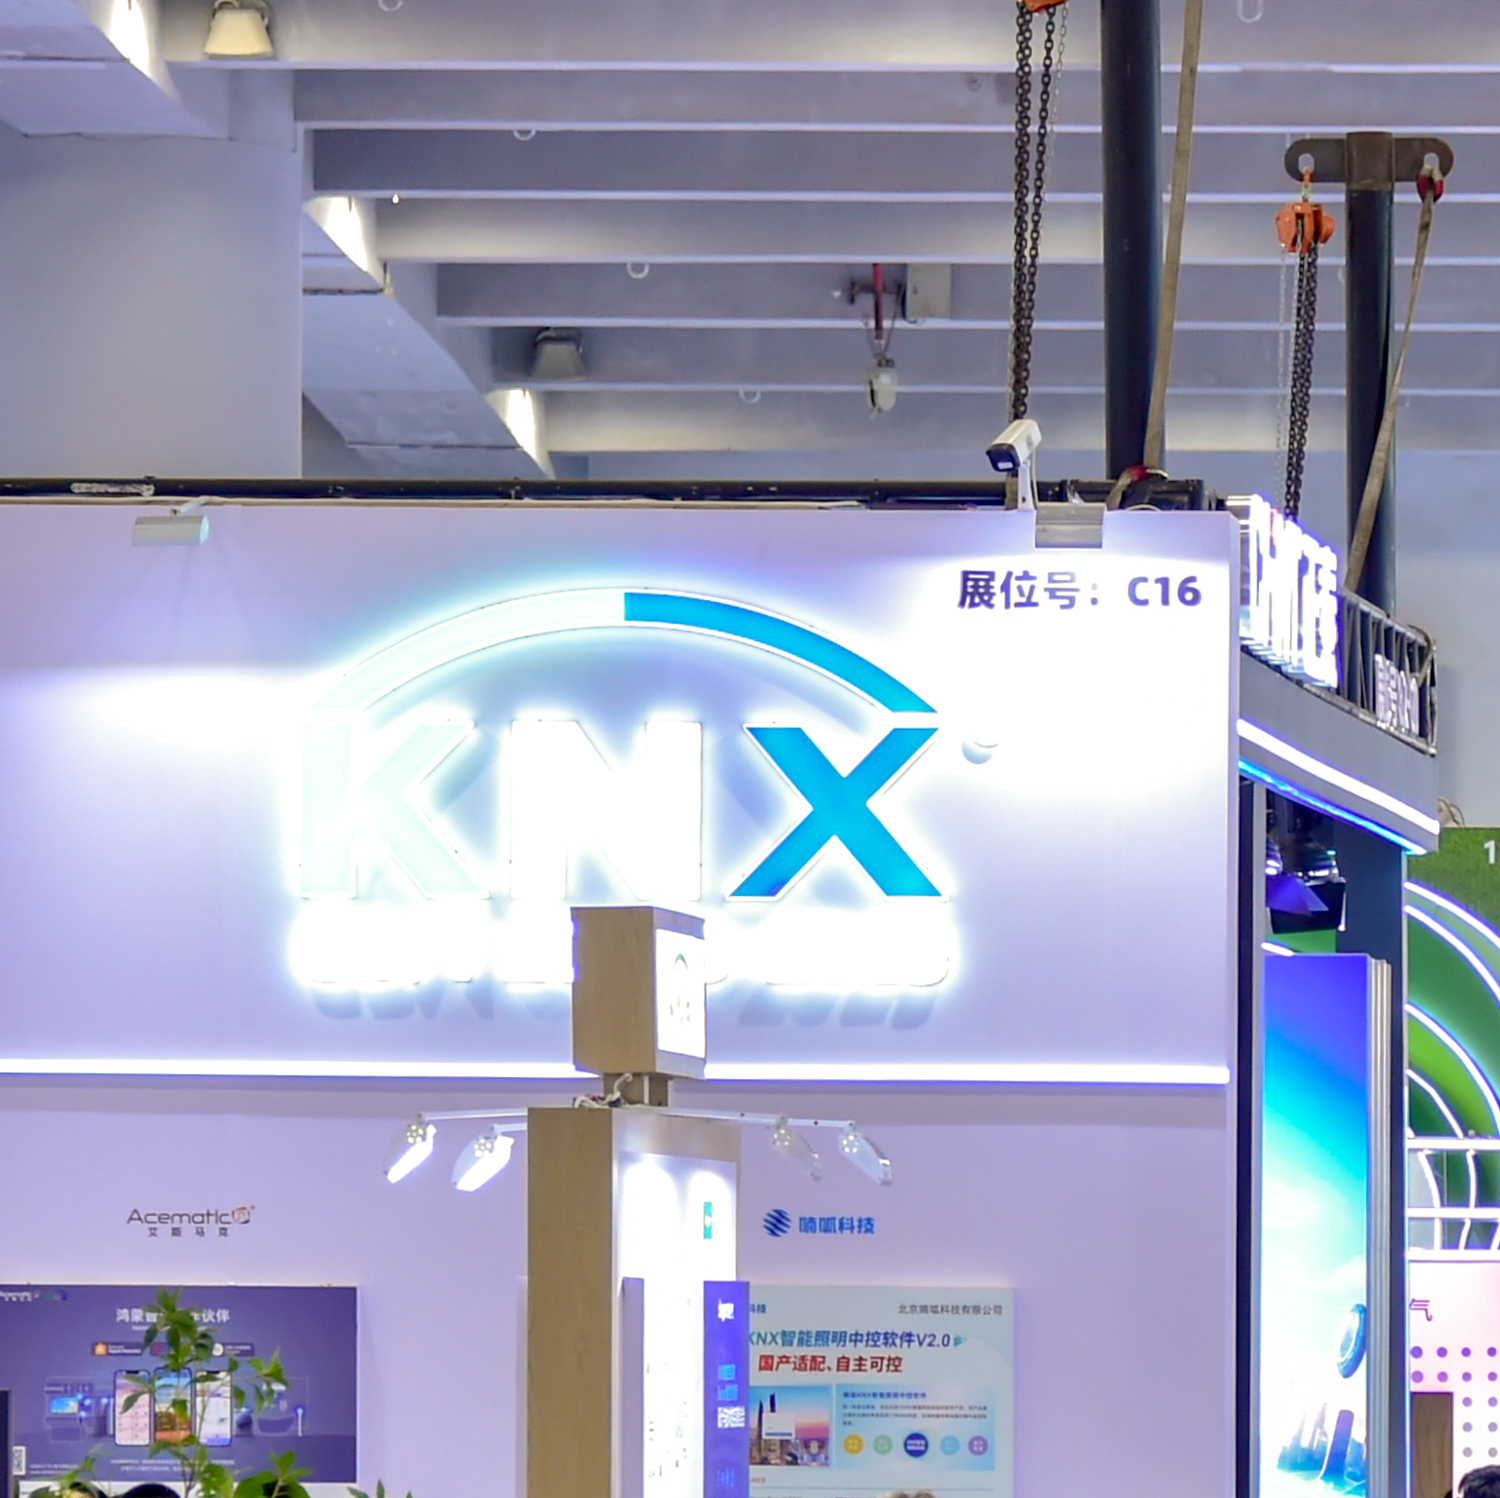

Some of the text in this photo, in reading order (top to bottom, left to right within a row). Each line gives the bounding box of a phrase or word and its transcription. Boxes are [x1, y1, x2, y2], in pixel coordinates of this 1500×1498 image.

[1127, 575, 1202, 607] C16
[298, 718, 950, 902] KNX
[126, 1208, 232, 1225] Acematic
[1409, 1297, 1433, 1322] 气
[758, 1354, 904, 1373] 国产适配、自主可控
